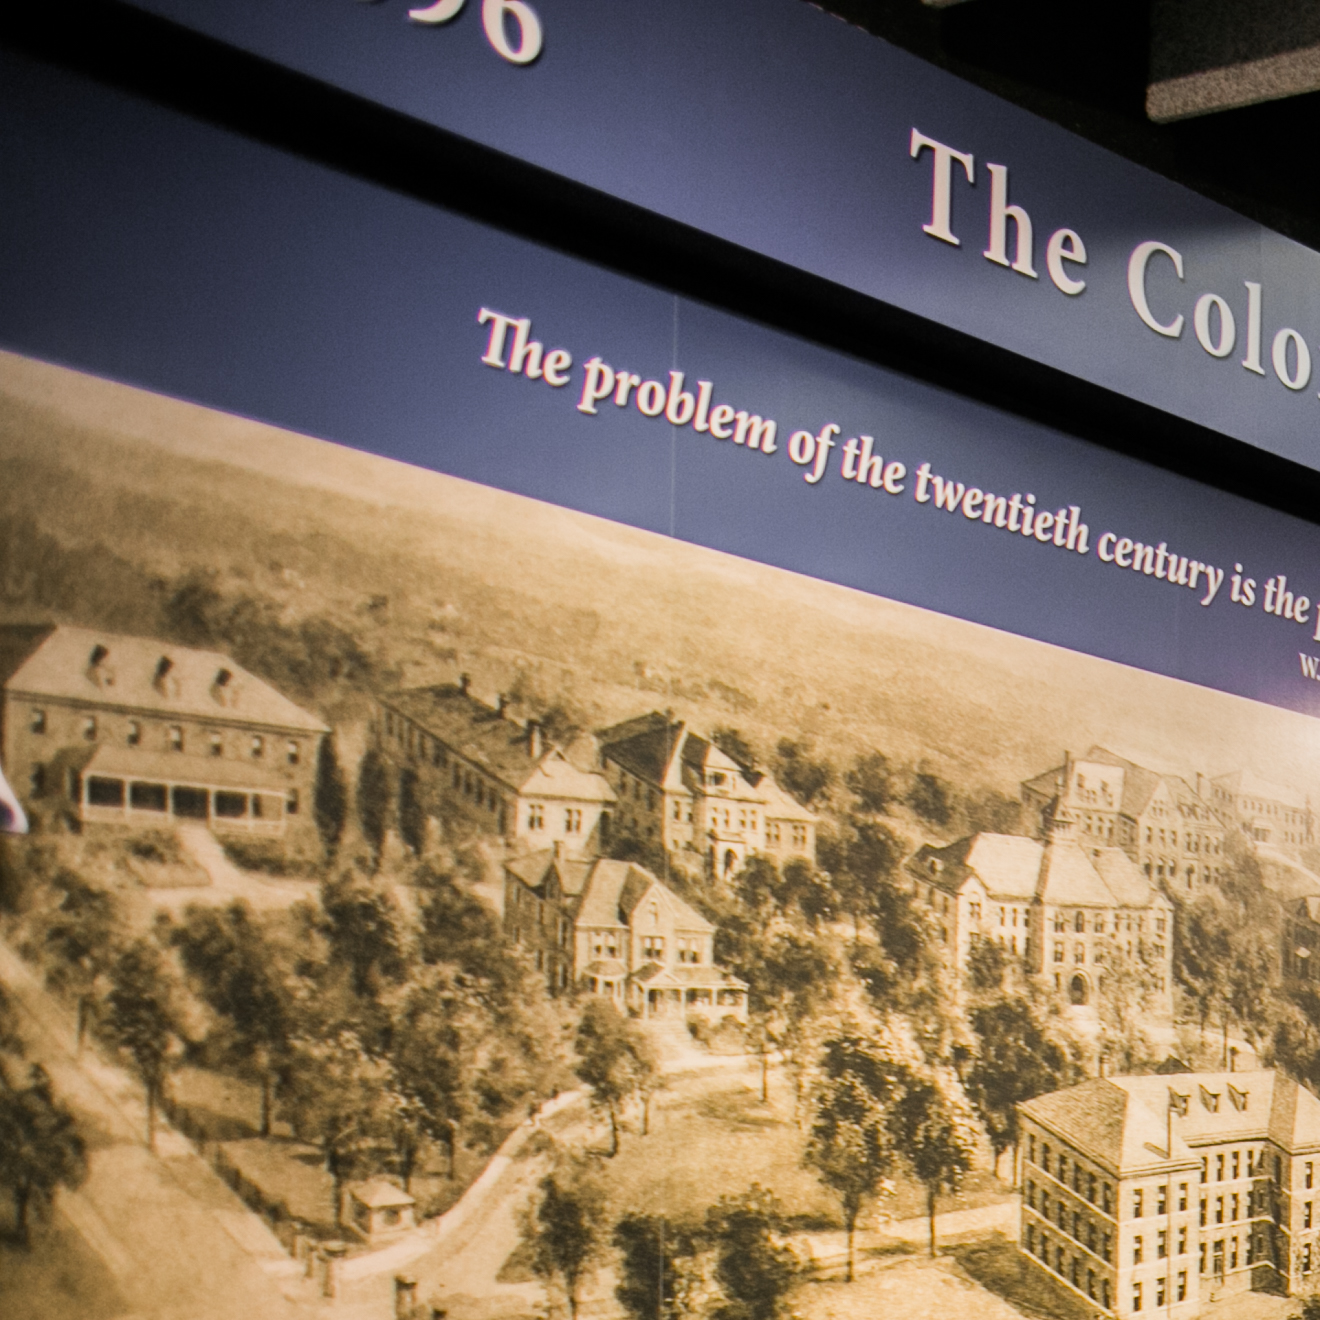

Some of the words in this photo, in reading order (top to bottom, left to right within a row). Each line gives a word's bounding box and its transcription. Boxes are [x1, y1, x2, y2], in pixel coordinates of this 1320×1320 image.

[910, 128, 1088, 295] The
[478, 307, 572, 386] The
[577, 356, 777, 453] problem
[788, 423, 840, 483] of
[841, 436, 906, 494] the
[914, 463, 1090, 554] twentieth
[1097, 531, 1224, 605] century
[1230, 562, 1256, 606] is
[1263, 575, 1310, 623] the
